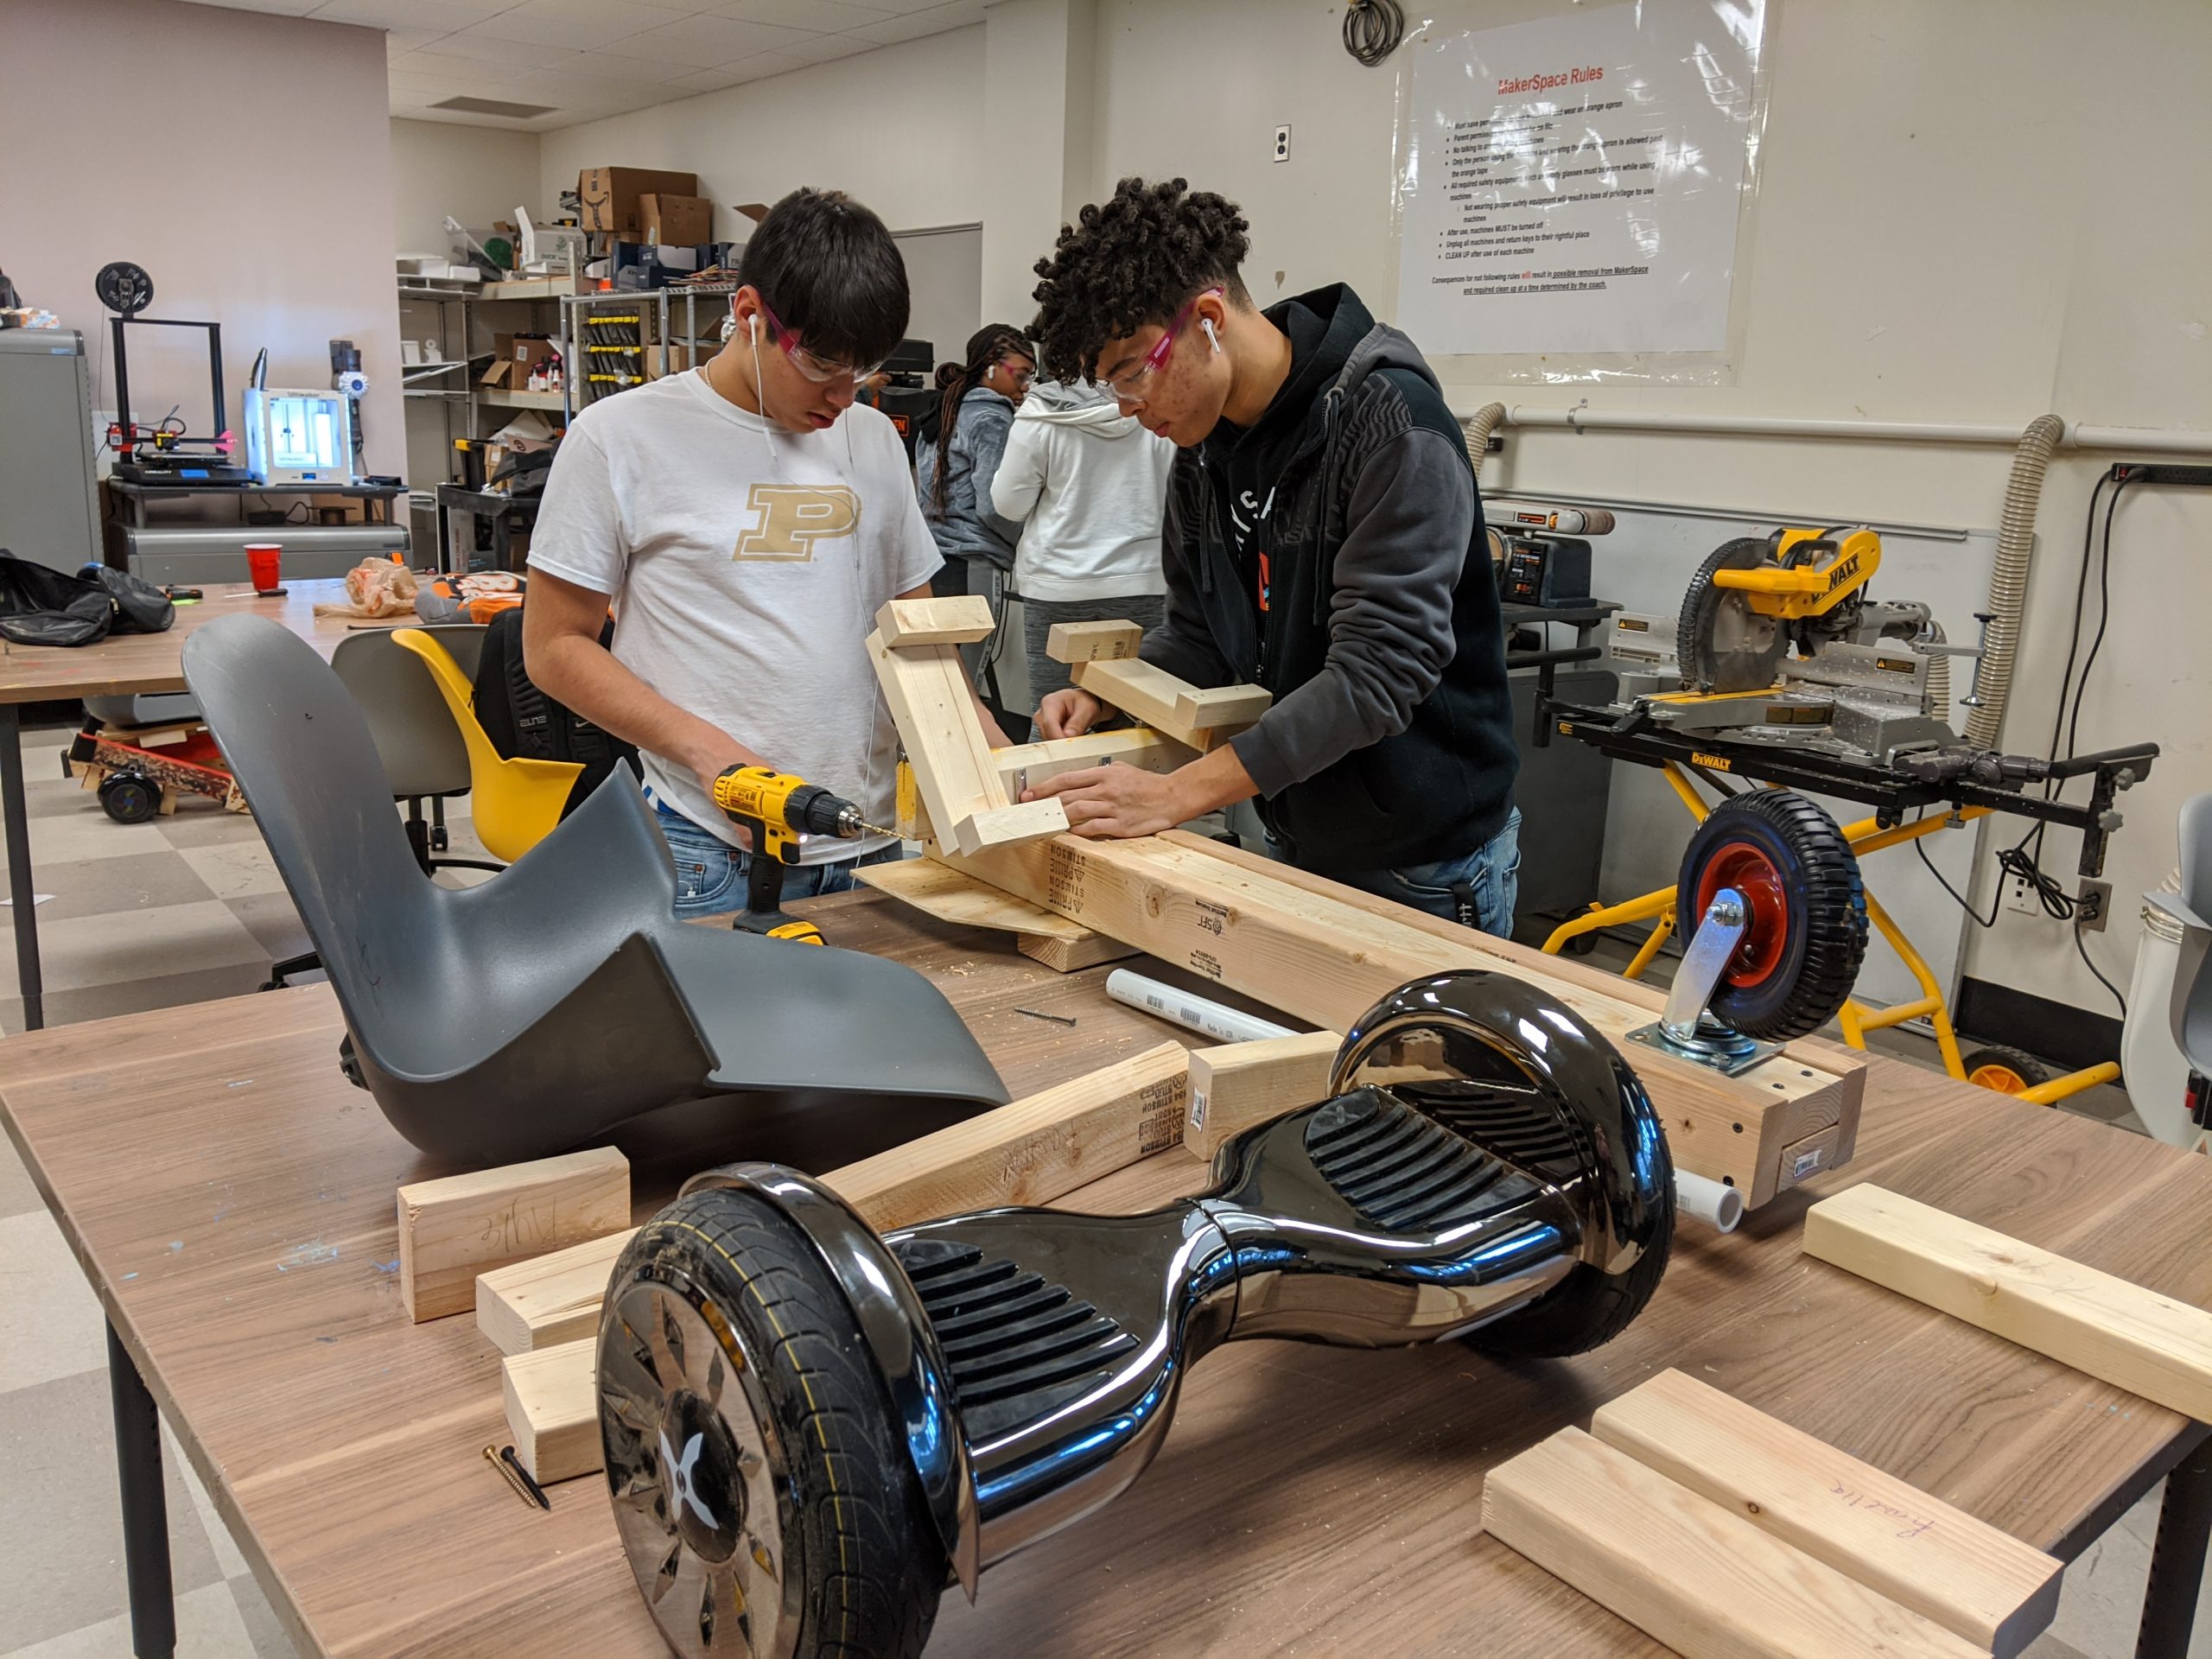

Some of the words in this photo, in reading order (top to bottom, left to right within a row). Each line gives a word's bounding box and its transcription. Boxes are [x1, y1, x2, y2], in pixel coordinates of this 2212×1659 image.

[1497, 73, 1567, 95] MakerSpace
[1571, 67, 1604, 84] Rules
[1585, 103, 1605, 112] range
[1605, 101, 1623, 111] apron
[1461, 144, 1477, 153] talking
[1472, 156, 1490, 164] person
[1600, 139, 1618, 148] pron
[1625, 136, 1649, 145] allowed
[1459, 180, 1478, 188] required
[1495, 176, 1521, 185] equipmen
[1562, 169, 1582, 179] glasses
[1529, 197, 1556, 206] equipment
[1609, 189, 1634, 200] privilege
[1471, 238, 1494, 246] machines
[1554, 232, 1574, 241] rightful
[1575, 231, 1590, 240] place
[1432, 276, 1465, 284] Consequences
[1484, 273, 1506, 282] following
[1522, 270, 1531, 279] will
[1553, 269, 1576, 278] possible
[1578, 267, 1599, 276] removal
[1614, 265, 1649, 275] MakerSpace
[1541, 283, 1569, 291] determined
[732, 483, 861, 563] P
[1051, 843, 1086, 867] STIMSON
[1049, 875, 1084, 898] STIMSON
[1142, 1096, 1173, 1114] STIMSON
